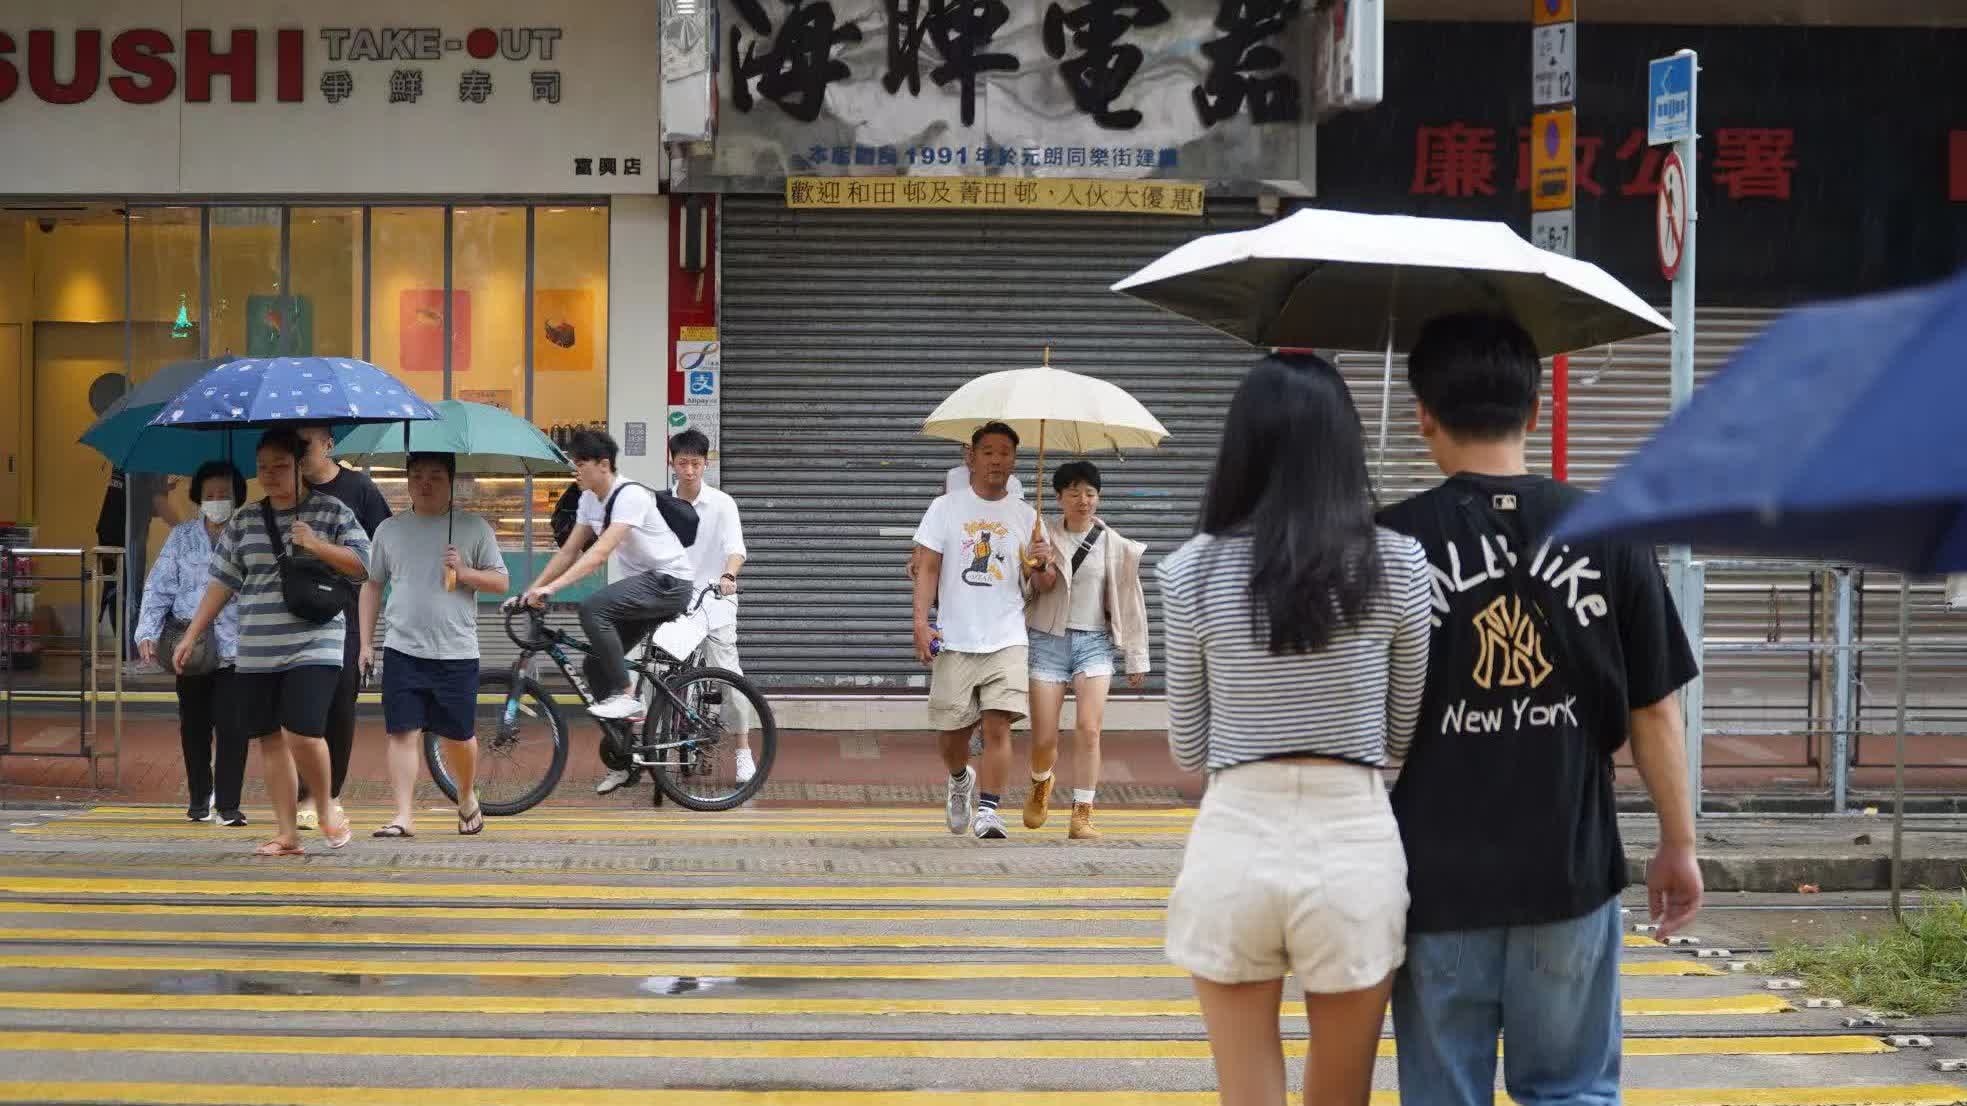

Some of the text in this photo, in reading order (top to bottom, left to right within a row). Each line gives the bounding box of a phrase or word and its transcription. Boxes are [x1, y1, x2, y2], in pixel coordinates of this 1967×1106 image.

[0, 28, 304, 104] USHI
[1441, 695, 1579, 735] New York
